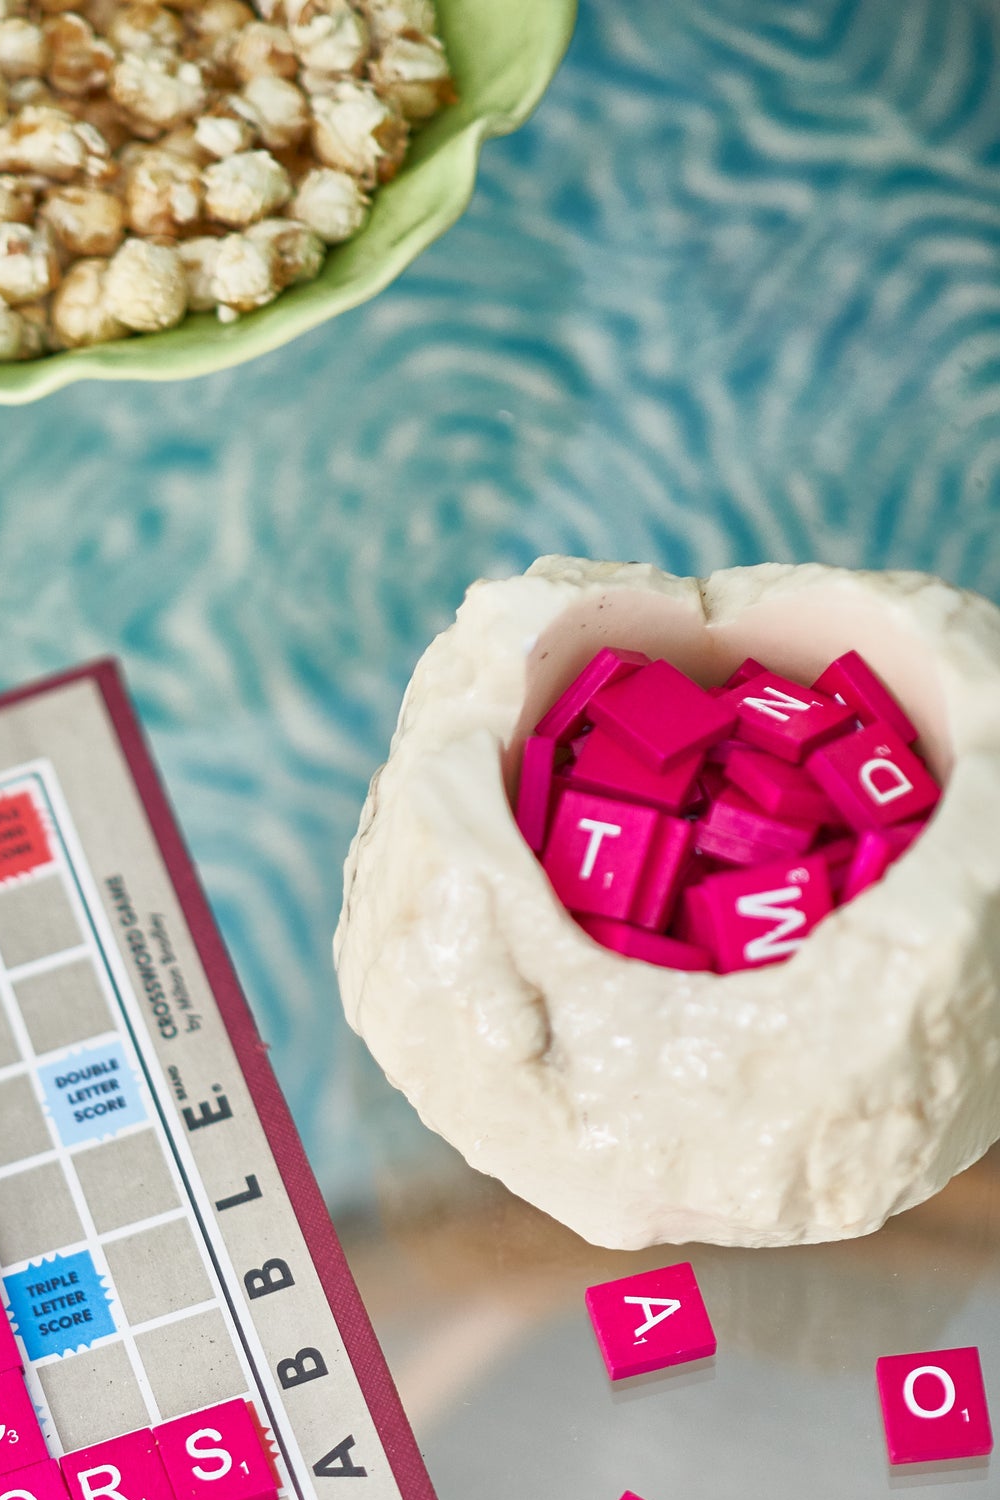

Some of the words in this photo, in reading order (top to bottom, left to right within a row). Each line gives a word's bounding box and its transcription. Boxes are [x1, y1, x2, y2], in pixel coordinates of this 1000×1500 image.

[858, 758, 913, 806] D
[579, 819, 621, 877] T
[126, 929, 178, 1040] CROSSWORD
[55, 1059, 118, 1088] DOUBLE
[68, 1079, 119, 1104] LETTER
[74, 1097, 125, 1122] SCORE
[25, 1270, 80, 1297] TRIPLE
[32, 1292, 86, 1320] LETTER
[624, 1295, 681, 1337] A
[38, 1308, 93, 1336] SCORE
[902, 1365, 956, 1420] O
